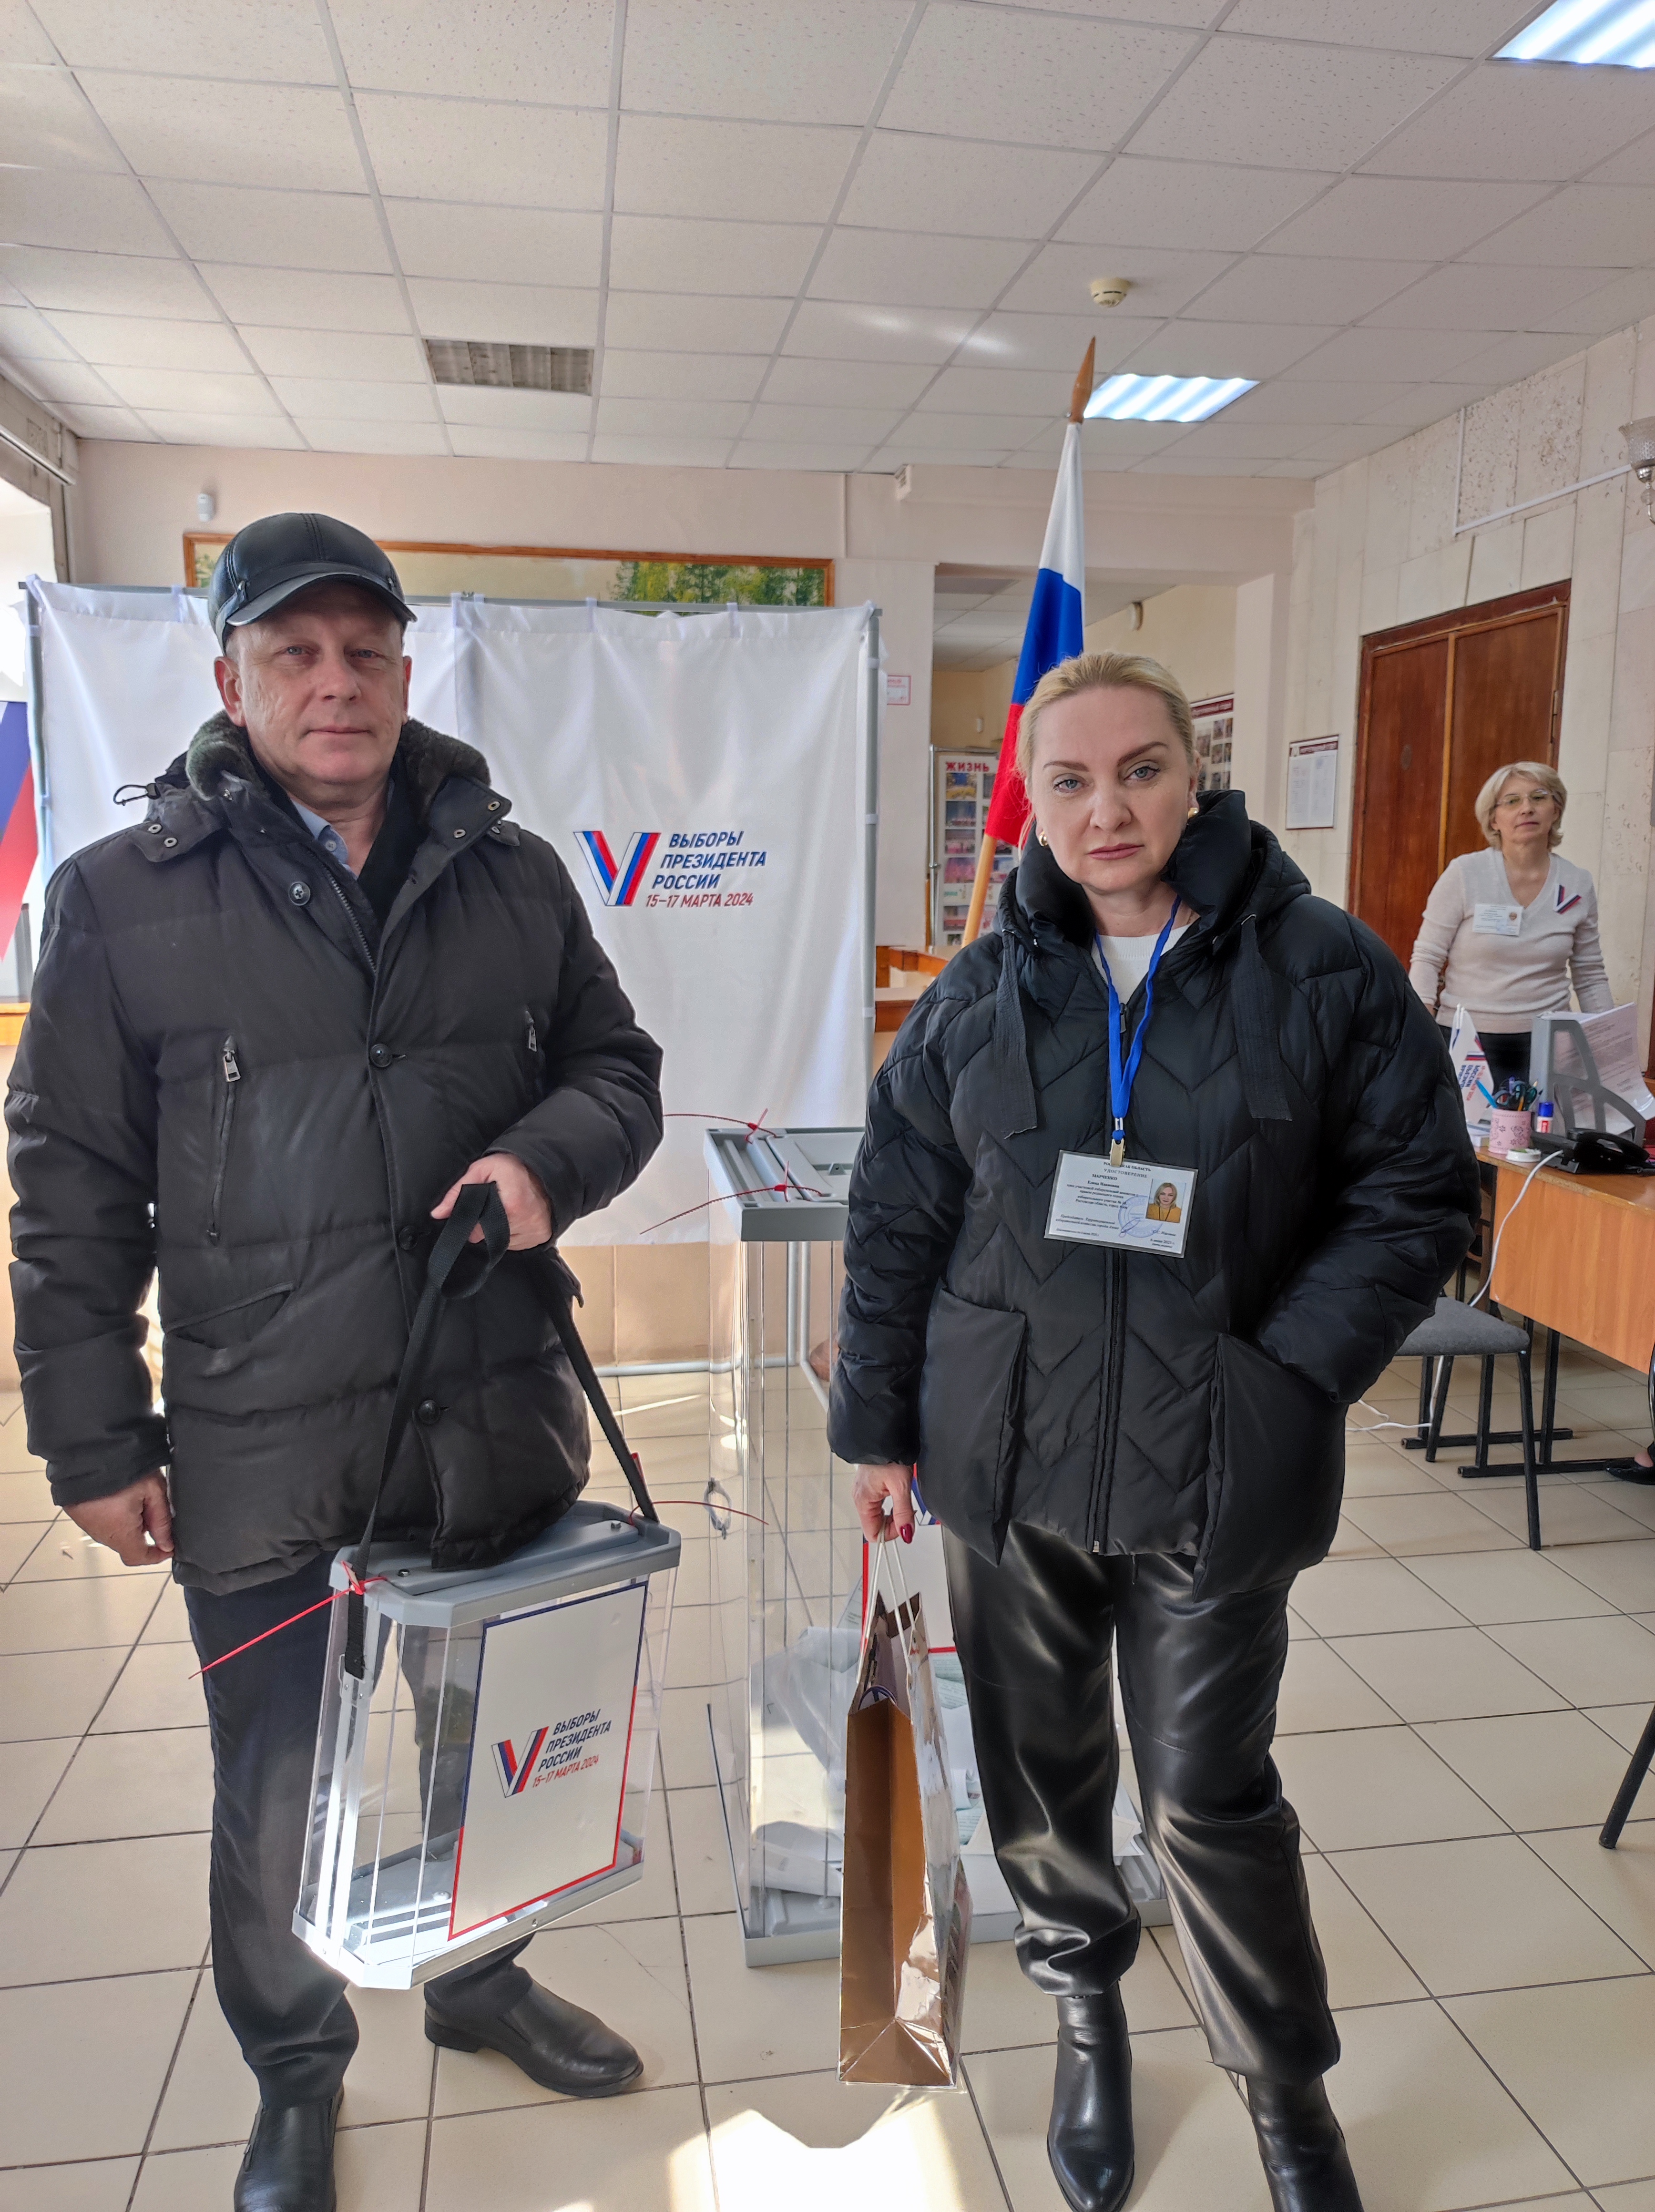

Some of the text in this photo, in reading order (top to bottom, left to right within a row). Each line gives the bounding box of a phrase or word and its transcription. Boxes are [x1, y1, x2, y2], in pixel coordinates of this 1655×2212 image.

[946, 761, 990, 772] ЖИЗНЬ
[669, 831, 744, 849] ВЫБОРЫ
[660, 851, 767, 870] ПРЕЗИДЕНТА
[652, 874, 721, 890] РОССИИ
[680, 894, 722, 908] МАРТА
[724, 892, 754, 907] 2024
[1104, 1168, 1148, 1178] УДОСТОВЕРЕНИЕ
[552, 1708, 601, 1736] ВЫБОРЫ
[545, 1720, 613, 1754] ПРЕЗИДЕНТА
[538, 1745, 583, 1772] РОССИИ
[553, 1760, 580, 1782] МАРТА
[580, 1754, 599, 1770] 2024
